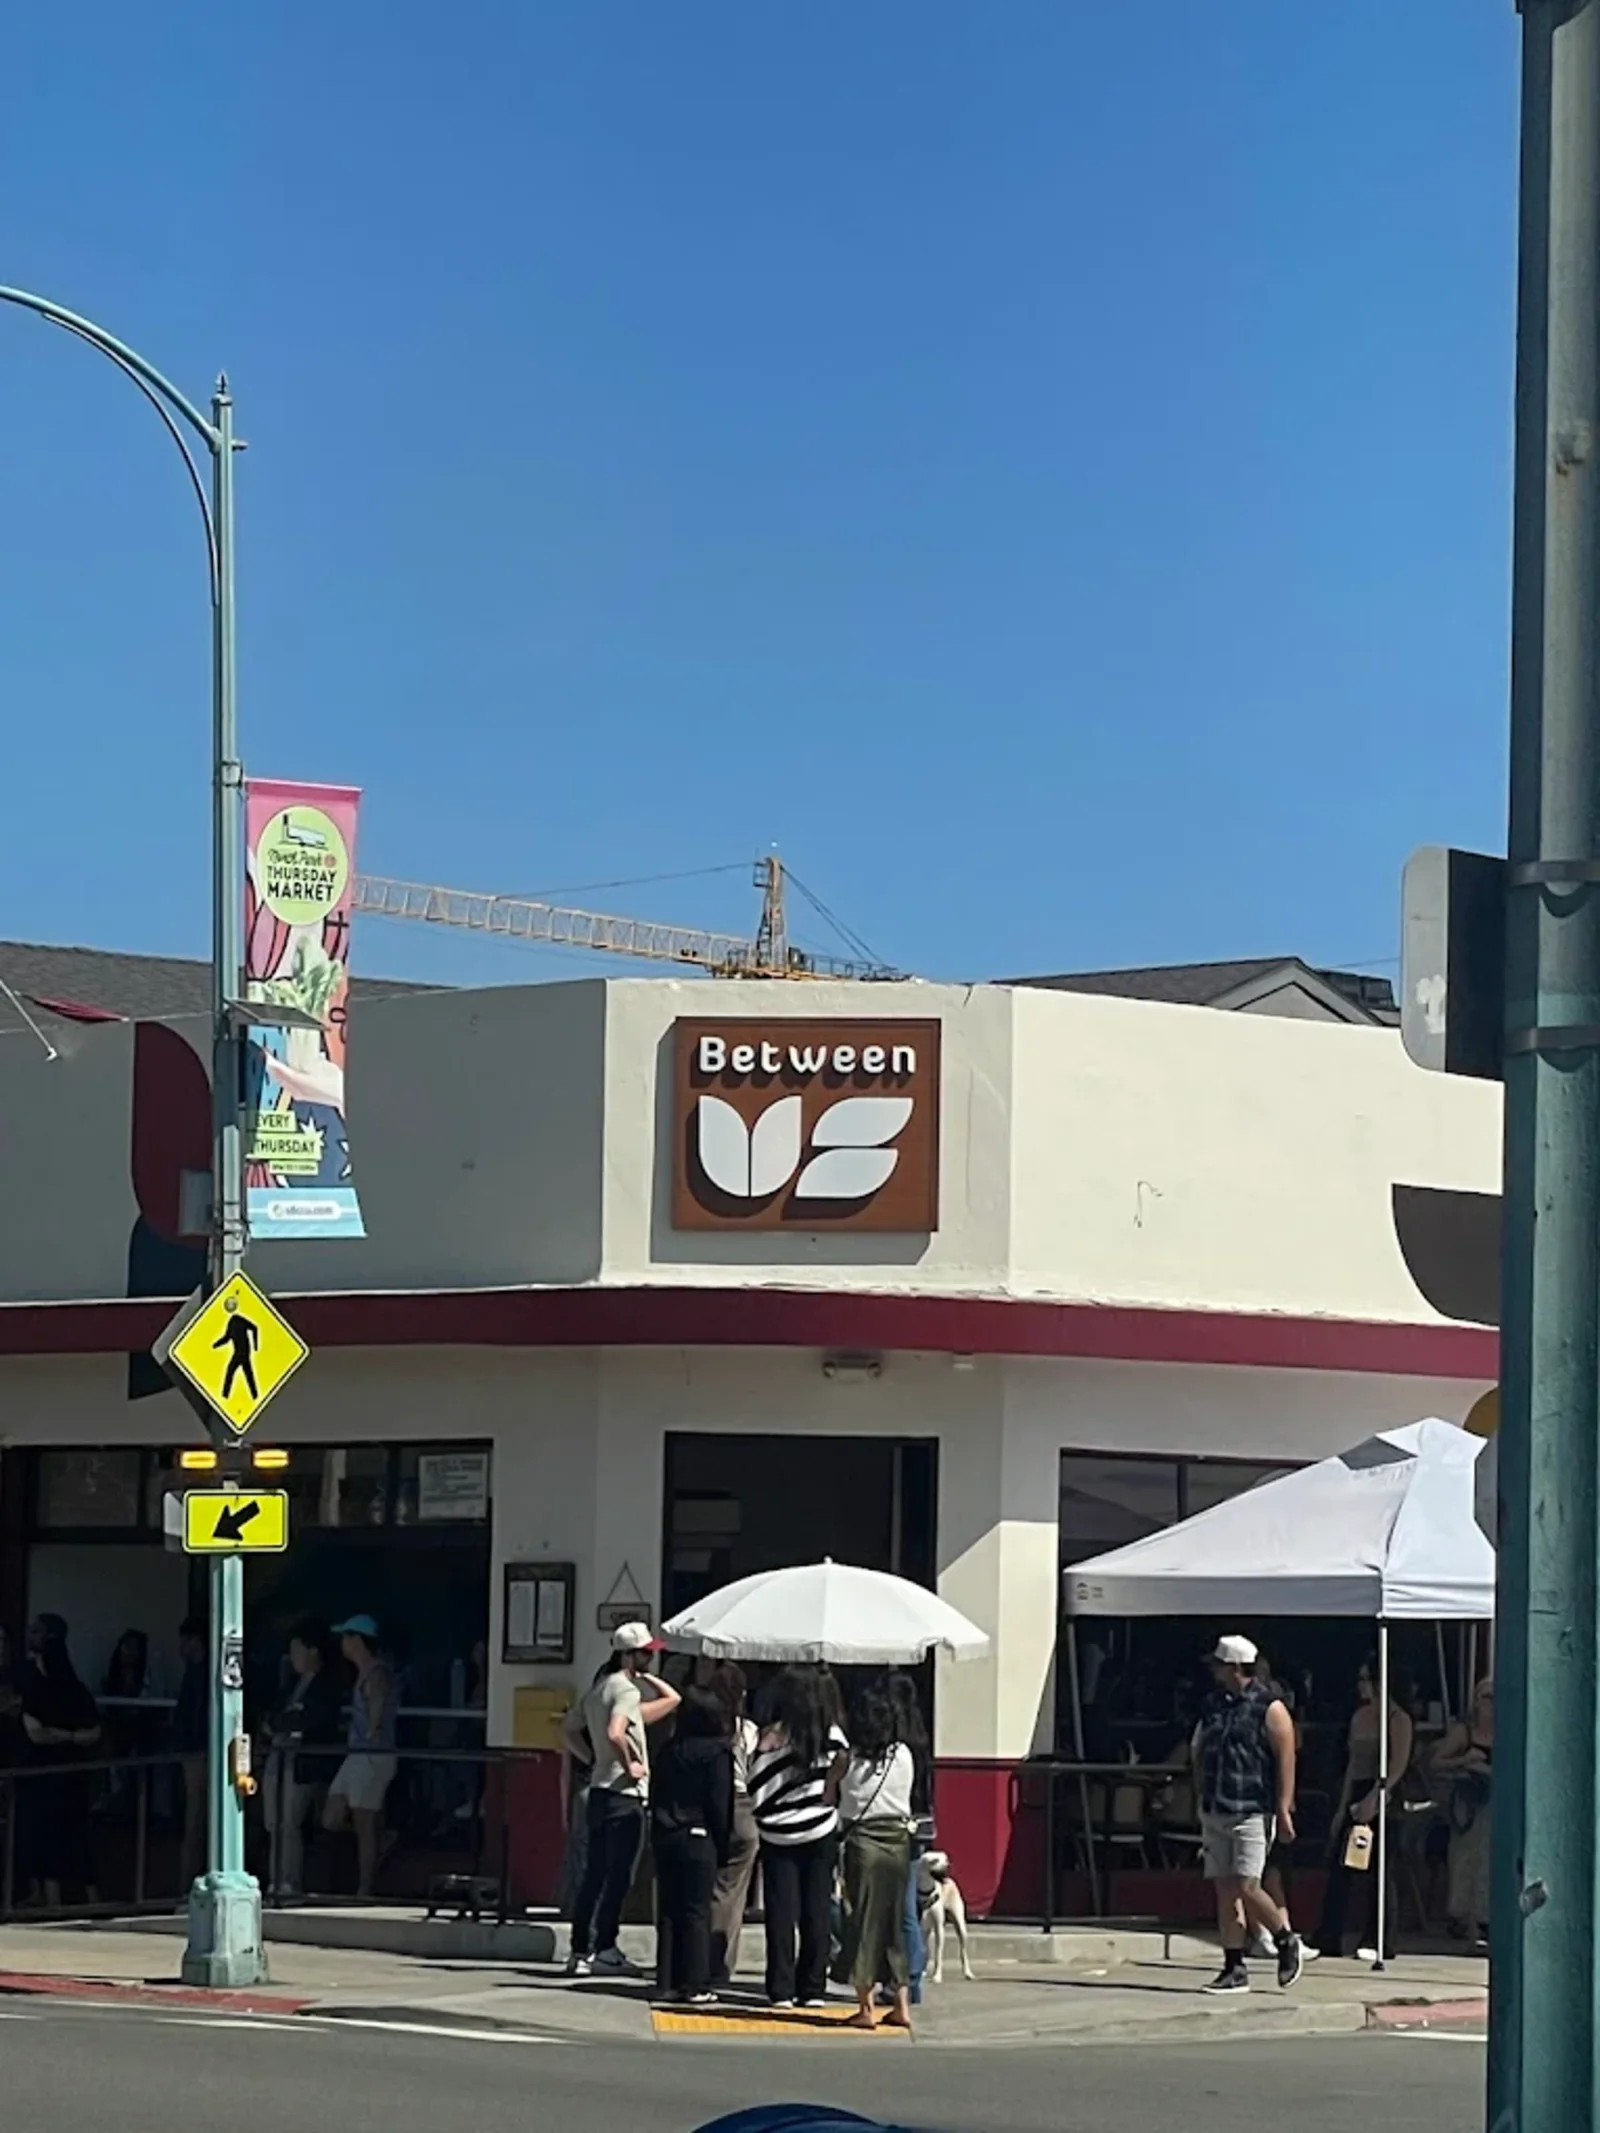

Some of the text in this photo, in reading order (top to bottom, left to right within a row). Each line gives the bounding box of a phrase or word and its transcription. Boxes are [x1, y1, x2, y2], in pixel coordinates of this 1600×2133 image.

[266, 864, 337, 883] THURSDAY
[267, 882, 334, 901] MARKET
[699, 1036, 916, 1073] Between
[256, 1113, 290, 1127] EVERY
[255, 1138, 316, 1153] THURSDAY
